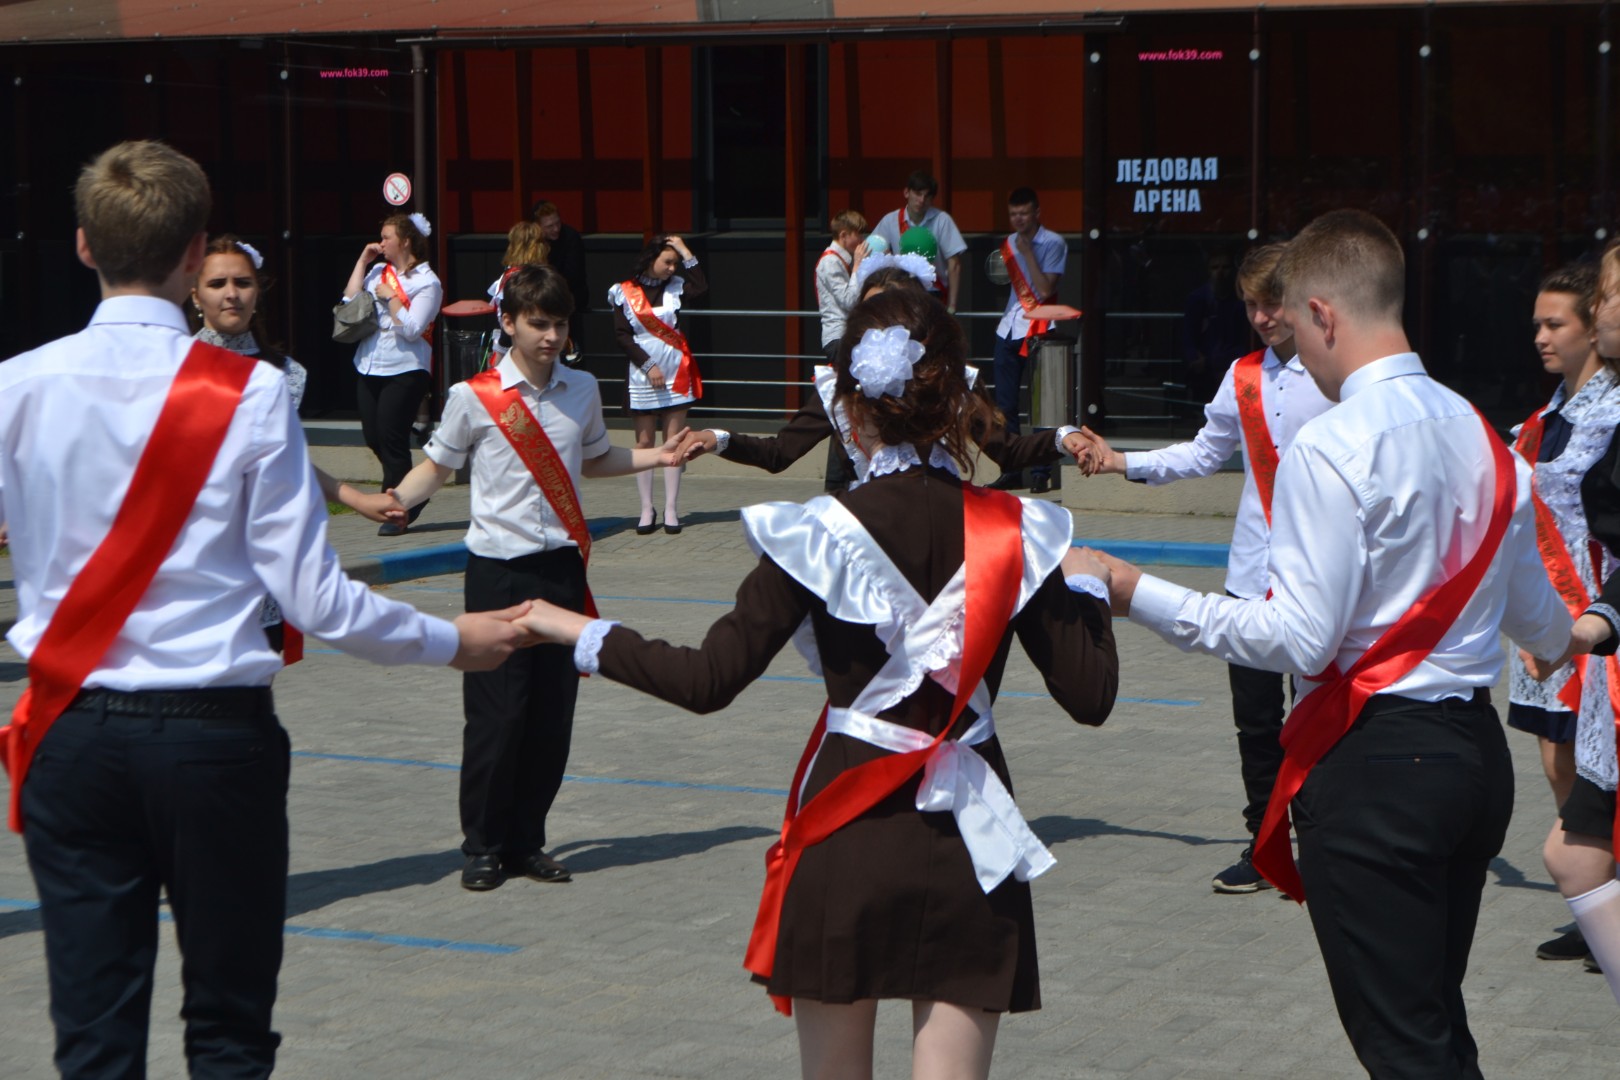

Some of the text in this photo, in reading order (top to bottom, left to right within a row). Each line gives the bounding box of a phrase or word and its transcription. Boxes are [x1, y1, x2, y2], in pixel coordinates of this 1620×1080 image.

[1138, 49, 1223, 61] www.fok39.com
[320, 67, 389, 78] www.fok39.com
[1116, 157, 1218, 186] ЛЕДОВАЯ
[1133, 188, 1202, 213] АРЕНА
